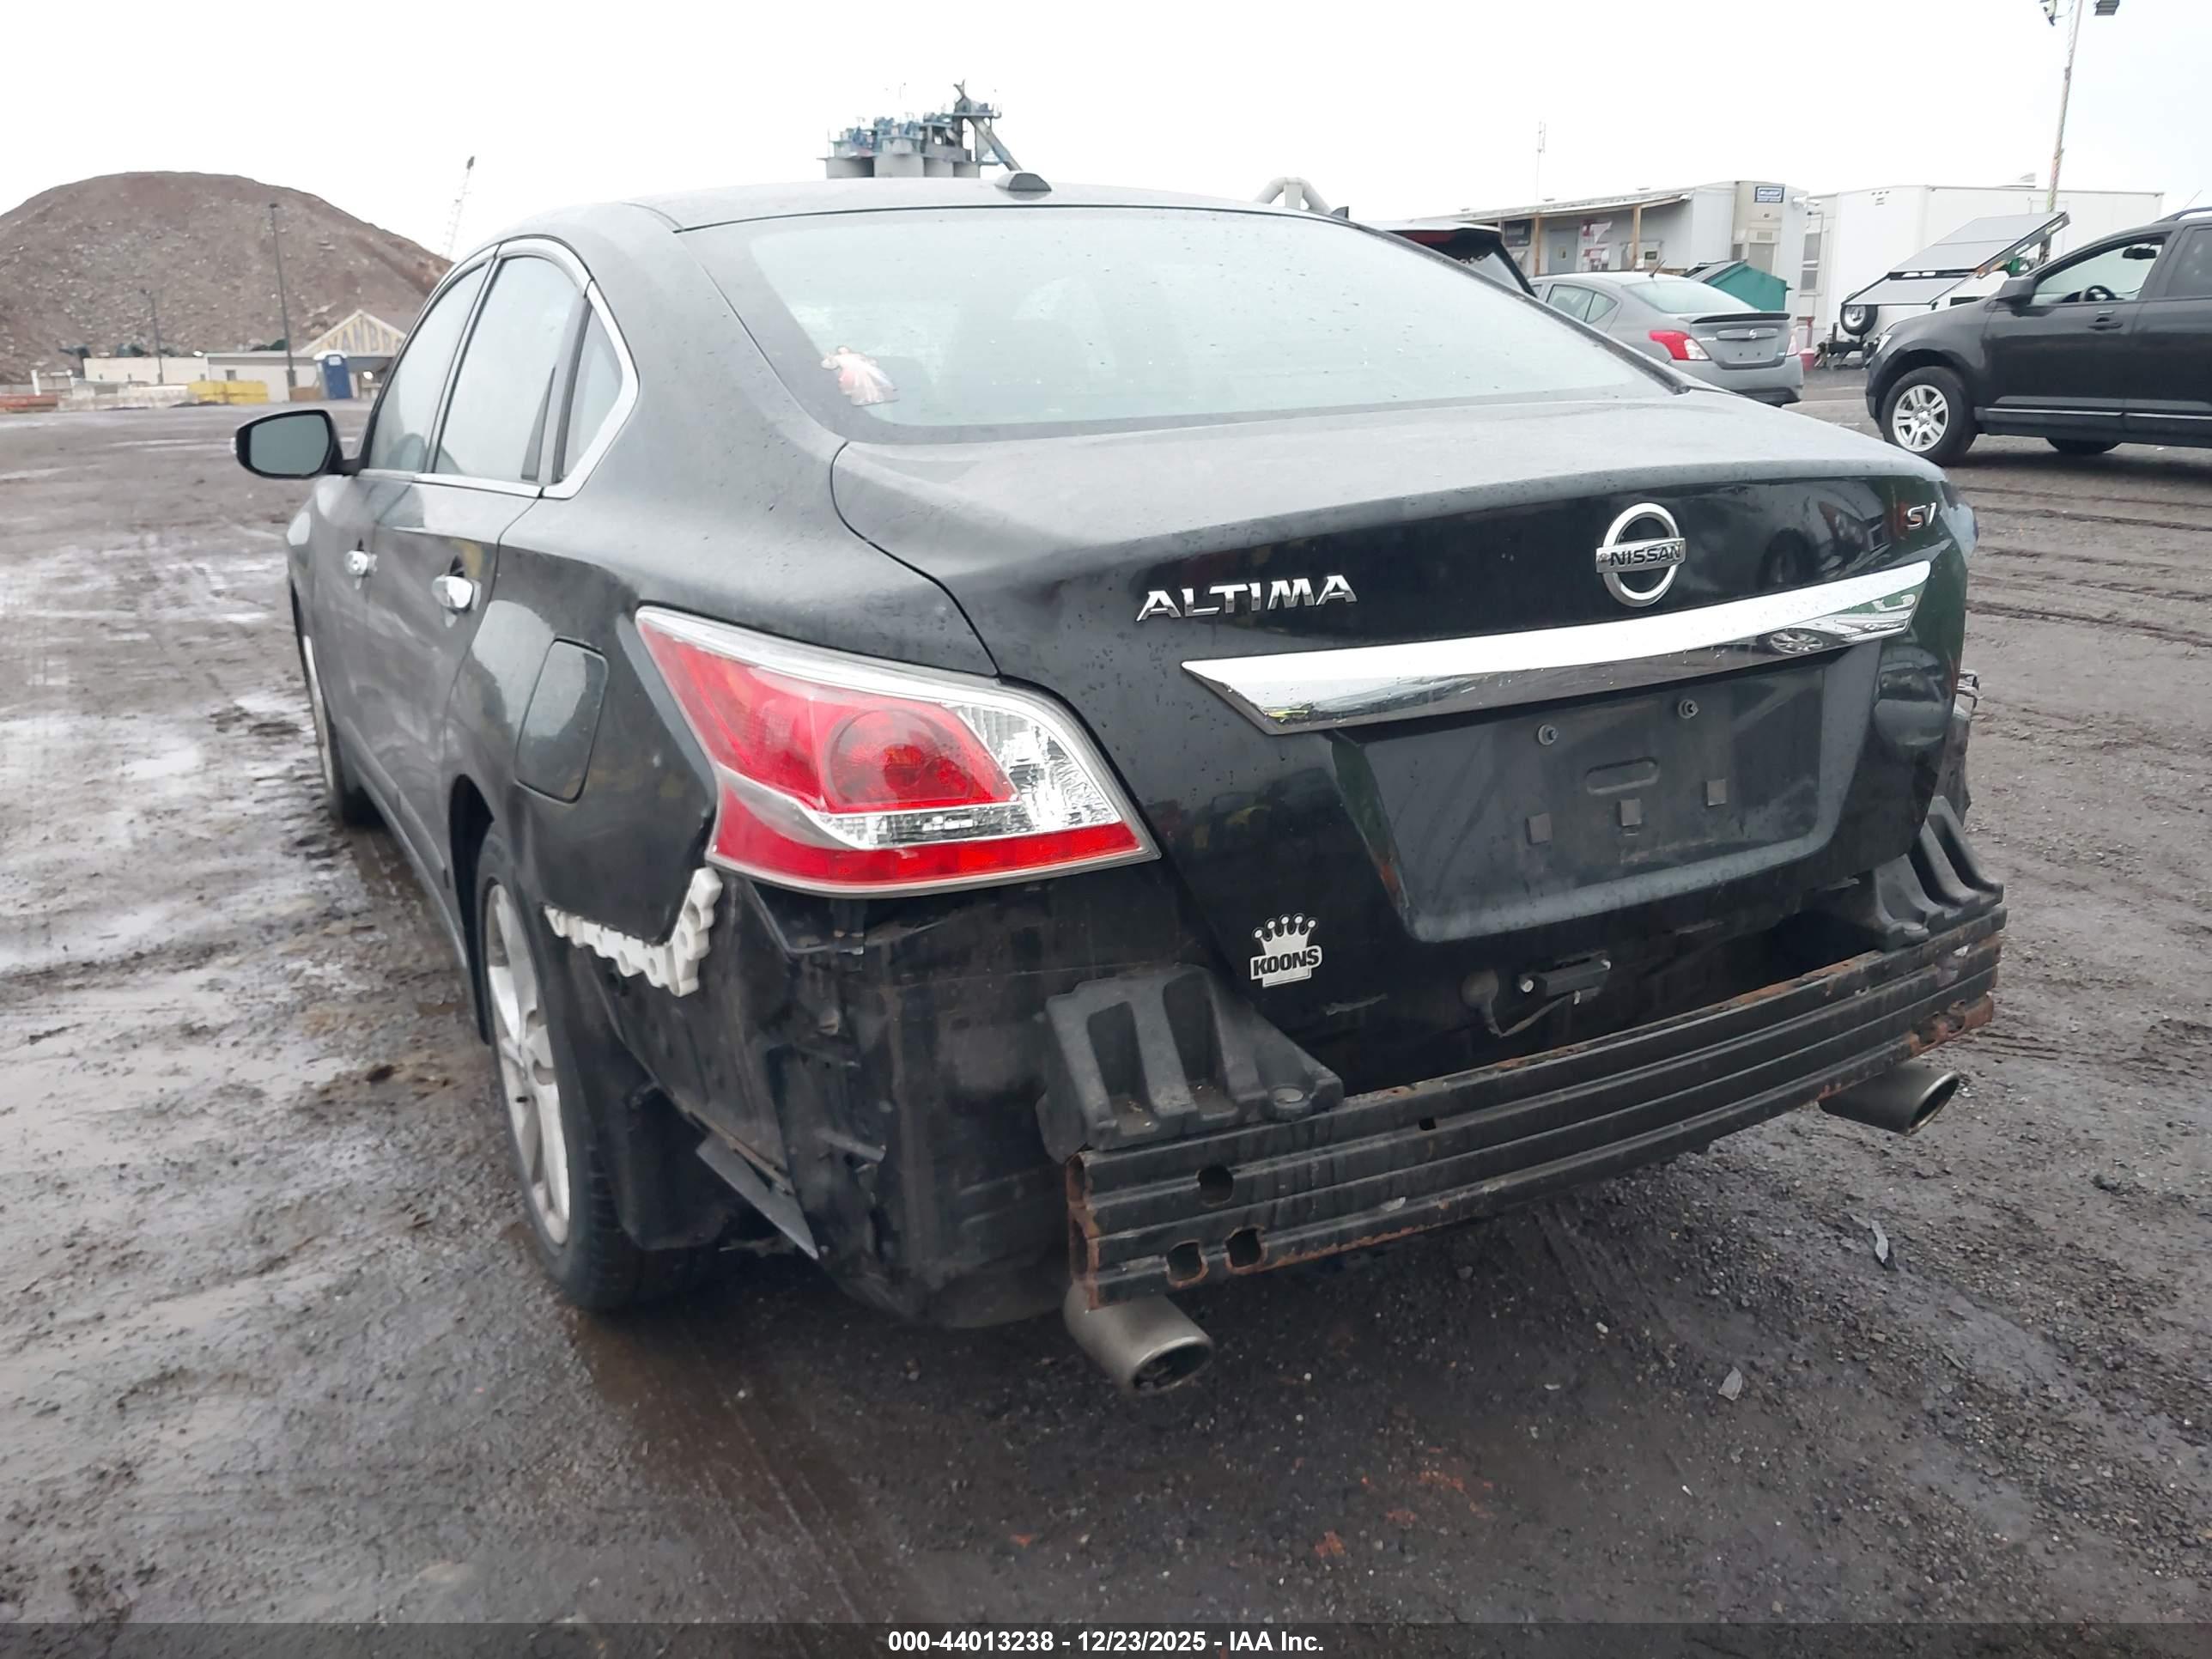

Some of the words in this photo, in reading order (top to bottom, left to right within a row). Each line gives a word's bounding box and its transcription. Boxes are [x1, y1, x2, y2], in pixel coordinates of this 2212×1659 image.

[1609, 544, 1681, 567] NISSAN
[1135, 574, 1358, 622] ALTIMA
[1253, 948, 1320, 977] KOONS
